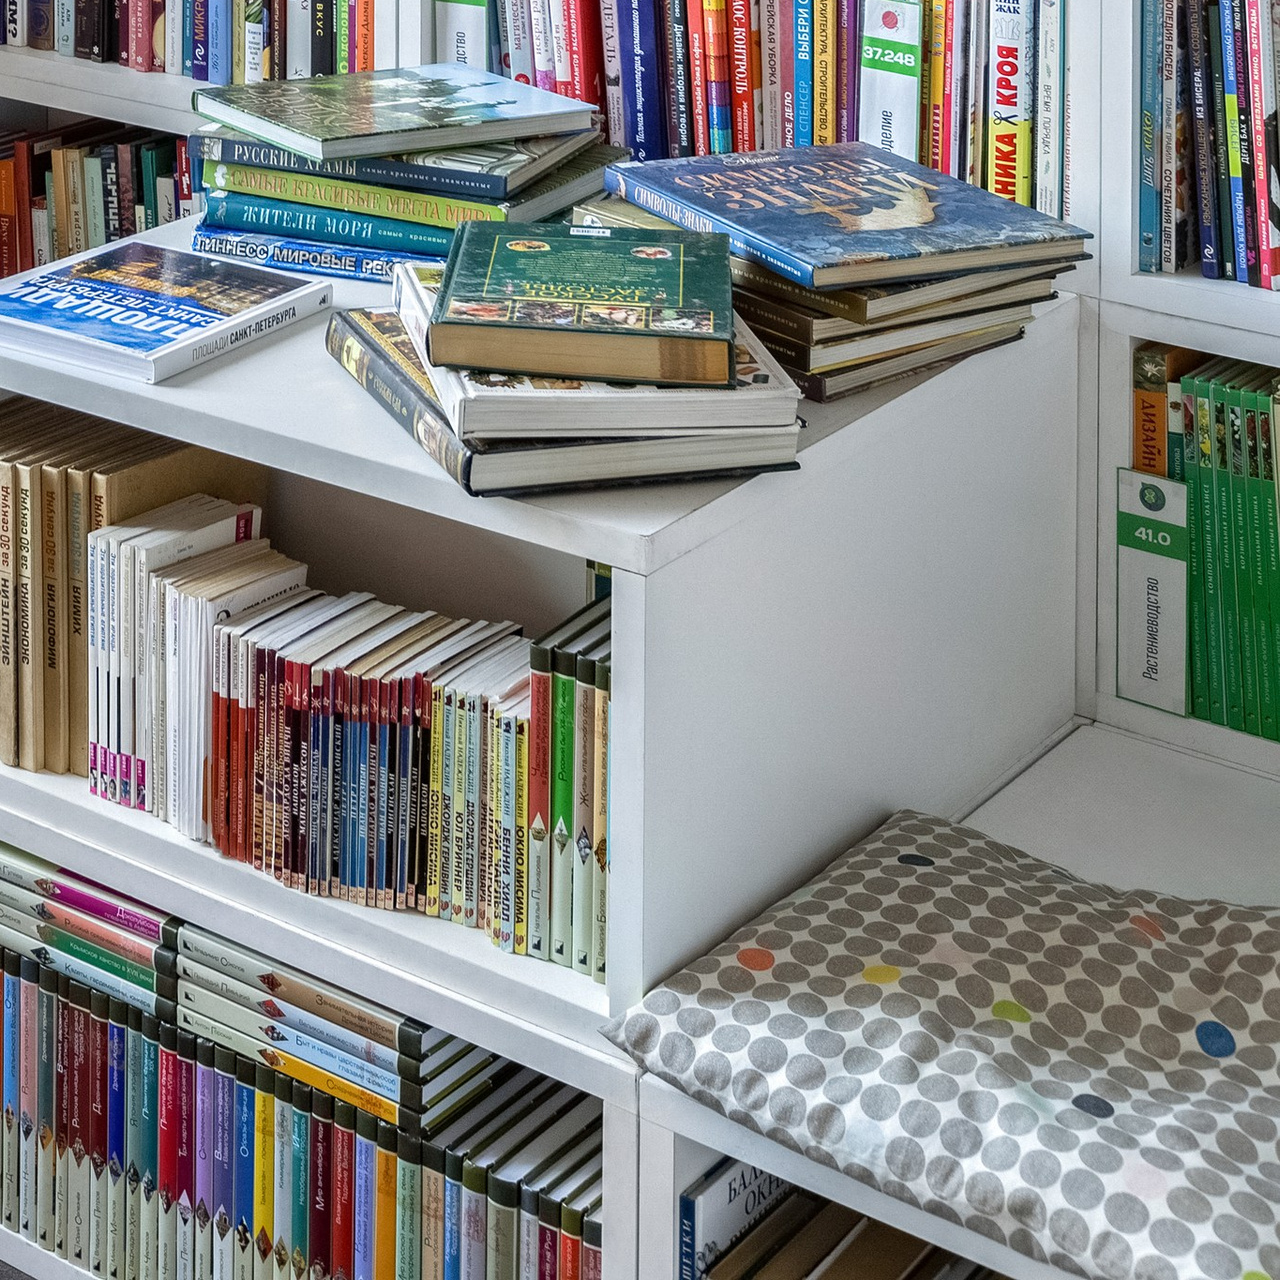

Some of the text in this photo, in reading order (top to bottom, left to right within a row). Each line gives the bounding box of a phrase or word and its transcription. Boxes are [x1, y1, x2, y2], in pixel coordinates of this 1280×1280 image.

[863, 48, 916, 70] 37.248
[994, 45, 1019, 109] КРОЯ
[234, 144, 298, 170] РУССКИЕ
[230, 169, 440, 220] САМЫЕ КРАСИВЫЕ МЕСТА
[243, 206, 374, 238] ЖИТЕЛИ МОРЯ
[274, 246, 356, 272] МИРОВЫЕ
[230, 307, 297, 346] САНКТ-ПЕТЕРБУРГА
[1142, 398, 1156, 470] ДИЗАЙН
[1134, 527, 1171, 546] 41.0
[2, 578, 10, 666] ЭЙНШТЕЙН
[21, 581, 30, 665] ЭКОНОМИКА
[48, 583, 57, 669] МИФОЛОГИЯ
[73, 586, 81, 636] ХИМИЯ
[1142, 577, 1159, 682] Растениеводство
